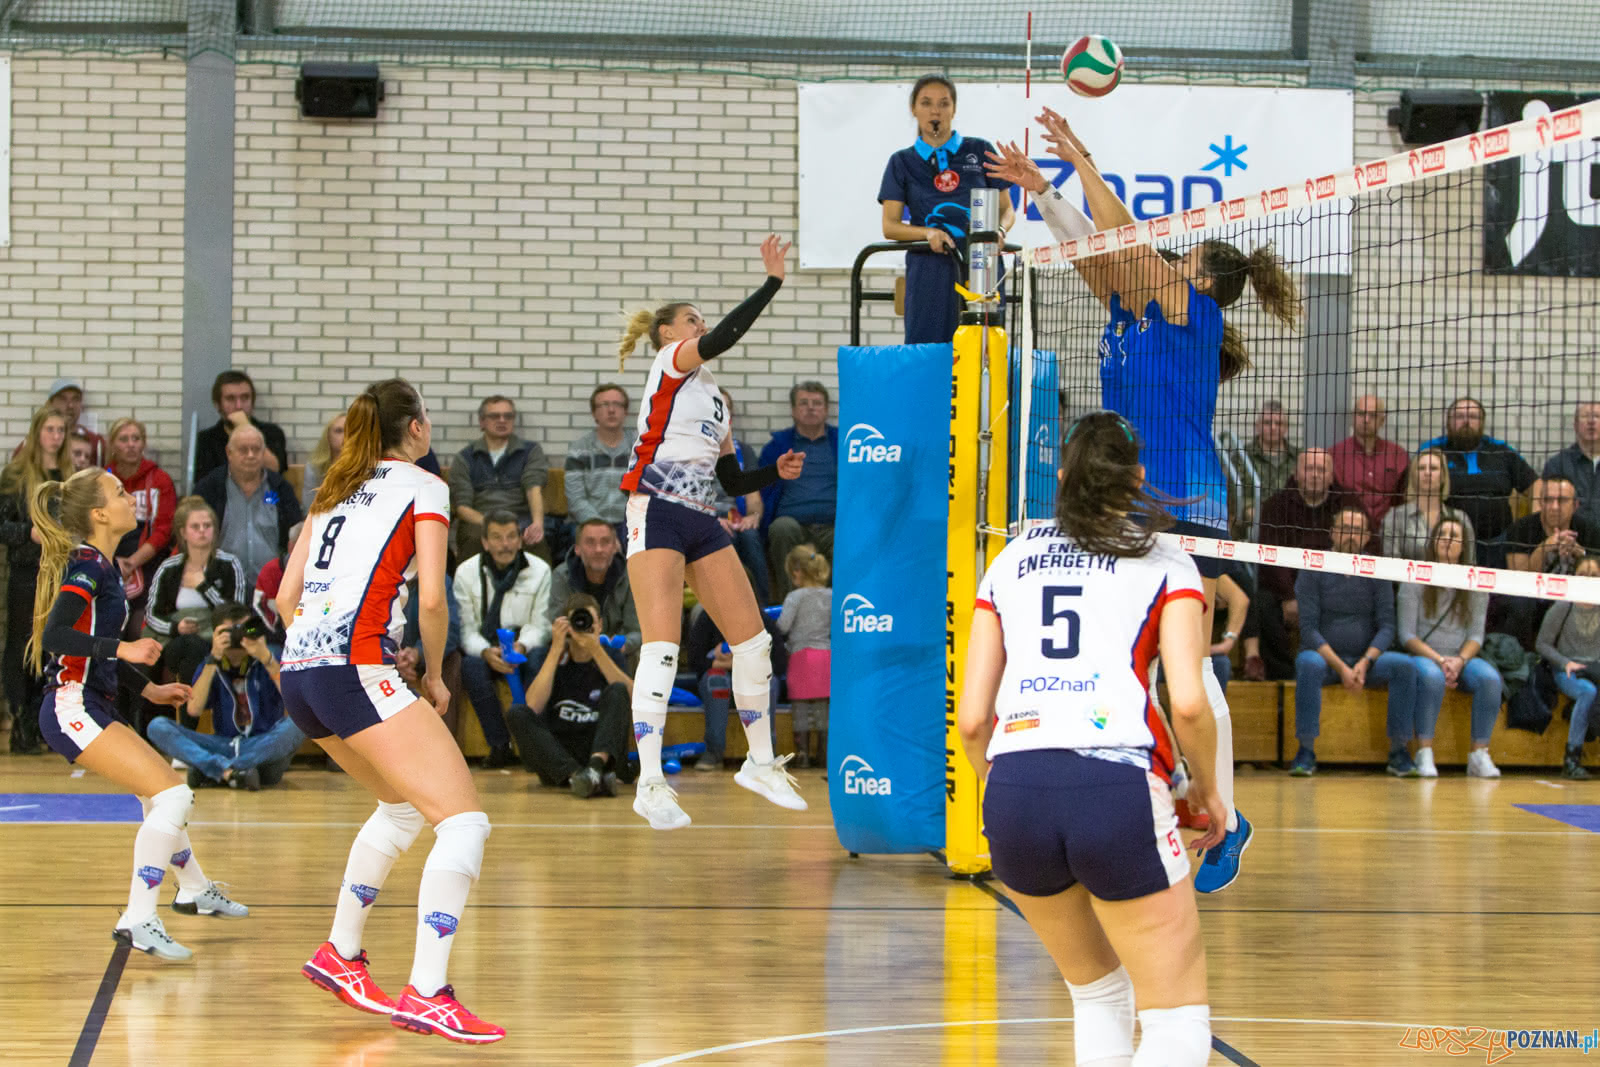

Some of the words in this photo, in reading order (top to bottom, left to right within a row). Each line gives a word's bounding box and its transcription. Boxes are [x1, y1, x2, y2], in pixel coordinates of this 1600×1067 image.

[713, 396, 724, 424] 9
[847, 436, 902, 464] Enea
[314, 515, 346, 570] 8
[1047, 543, 1088, 554] ENE
[1018, 554, 1118, 580] ENERGETYK
[843, 606, 893, 633] Enea
[1041, 585, 1084, 660] 5
[379, 679, 396, 697] 8
[1020, 676, 1096, 695] POZnan
[844, 767, 892, 796] Enea
[1167, 831, 1181, 857] 5
